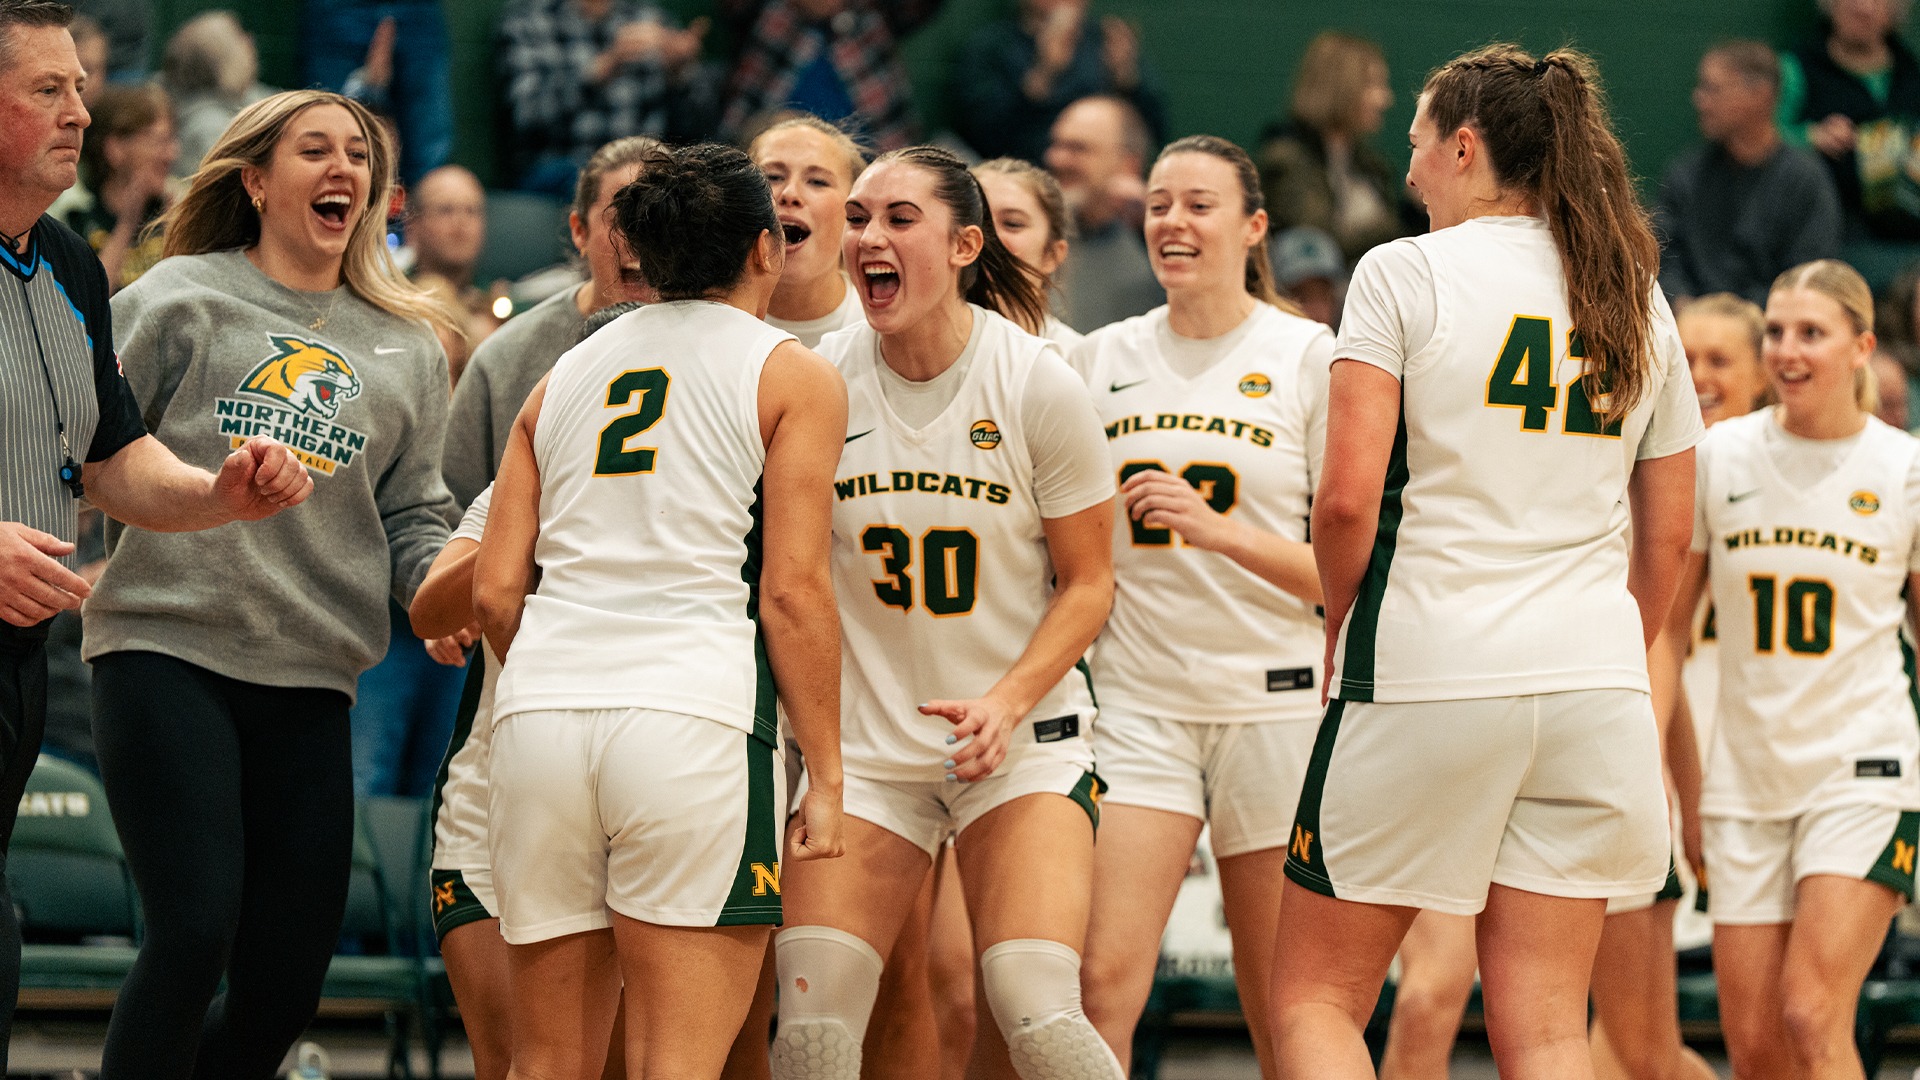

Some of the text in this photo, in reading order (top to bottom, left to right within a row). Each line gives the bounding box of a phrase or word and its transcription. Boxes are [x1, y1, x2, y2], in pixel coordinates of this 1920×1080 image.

[1484, 314, 1627, 440] 42
[217, 400, 365, 451] NORTHERN
[221, 418, 353, 465] MICHIGAN
[592, 366, 672, 477] 2
[1104, 413, 1275, 449] WILDCATS
[834, 470, 1012, 506] WILDCATS
[1724, 526, 1879, 566] WILDCATS
[859, 523, 980, 619] 30
[1748, 571, 1837, 660] 10
[1291, 823, 1313, 864] N
[751, 861, 781, 896] N
